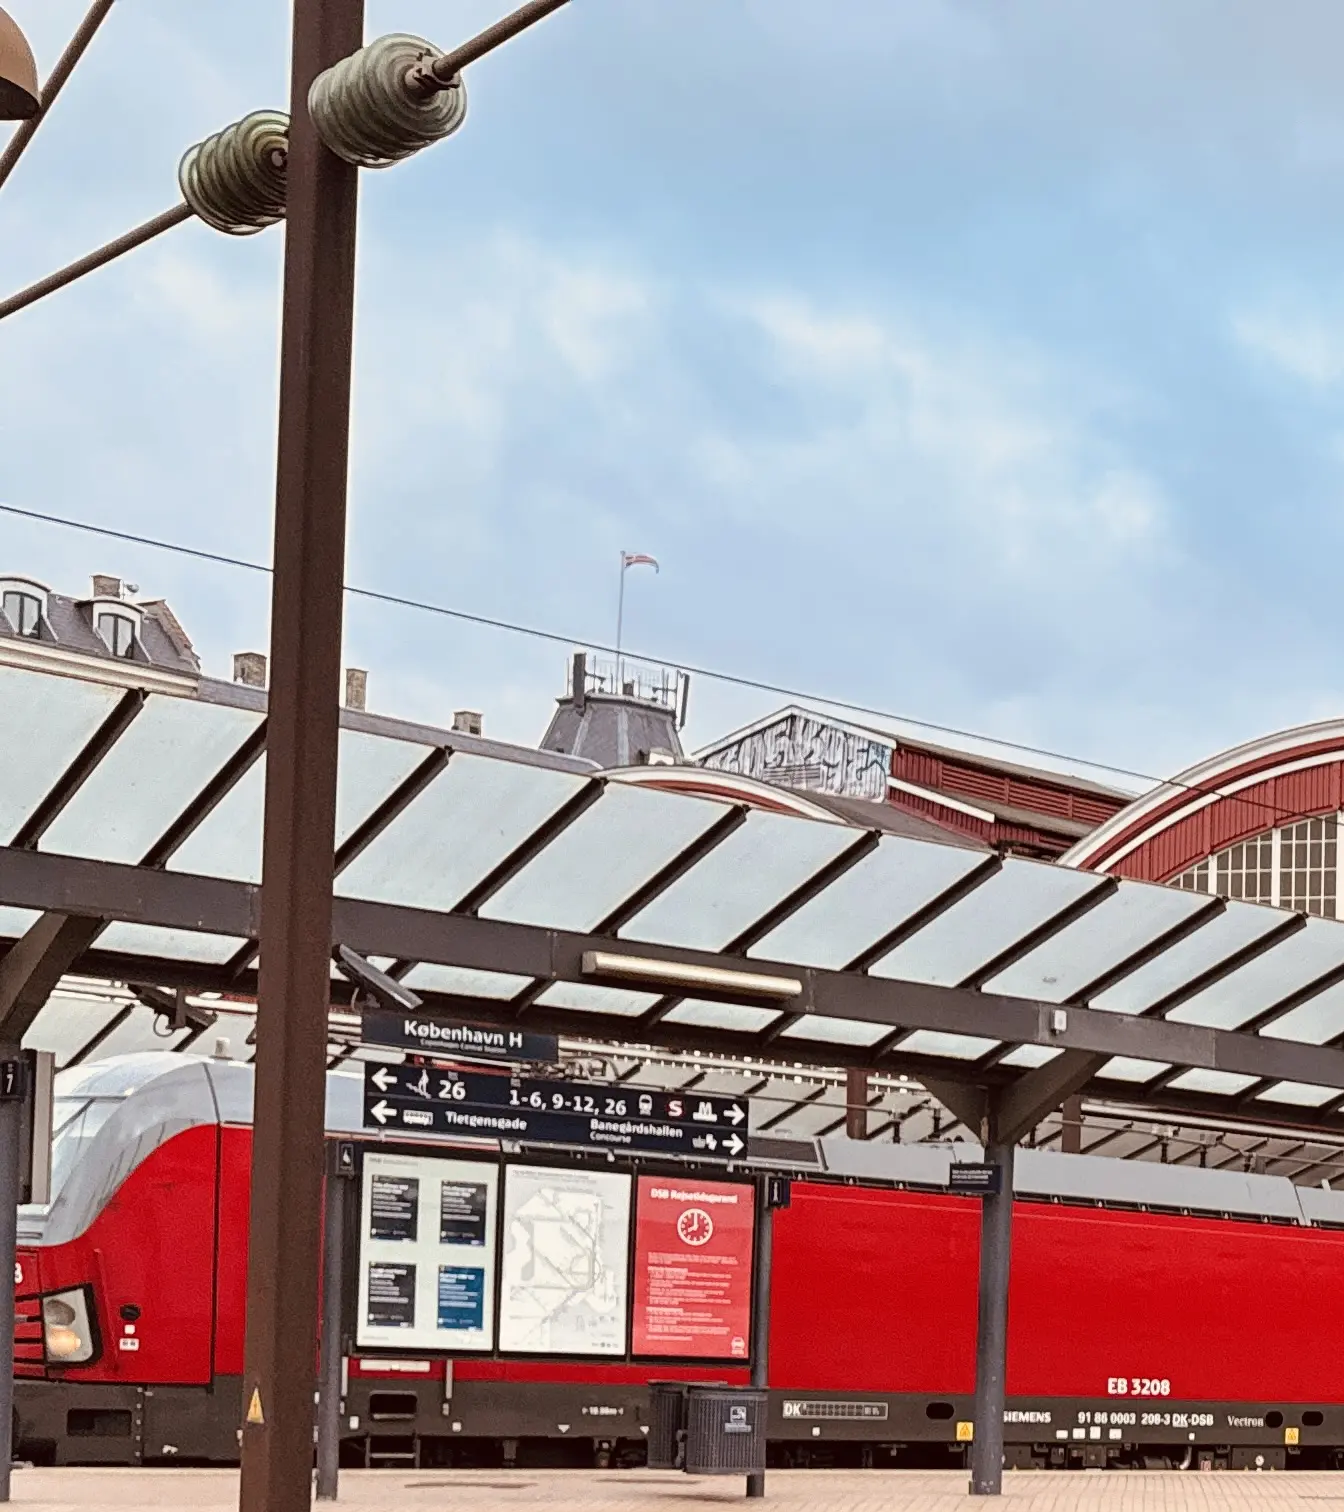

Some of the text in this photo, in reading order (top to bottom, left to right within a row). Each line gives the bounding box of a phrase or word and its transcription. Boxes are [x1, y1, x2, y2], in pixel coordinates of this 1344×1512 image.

[404, 1019, 504, 1046] København
[509, 1032, 523, 1048] H
[438, 1079, 466, 1100] 26
[509, 1089, 547, 1110] 1-6,
[551, 1093, 600, 1115] 9-12,
[604, 1099, 627, 1116] 26
[444, 1110, 528, 1131] Tietgensgade
[1107, 1377, 1171, 1396] EB 3208
[1003, 1411, 1052, 1423] SIEMENS
[1077, 1411, 1091, 1424] 91
[1110, 1412, 1136, 1425] 0003
[1172, 1412, 1214, 1428] DK-DSB
[1227, 1414, 1264, 1428] Vectron
